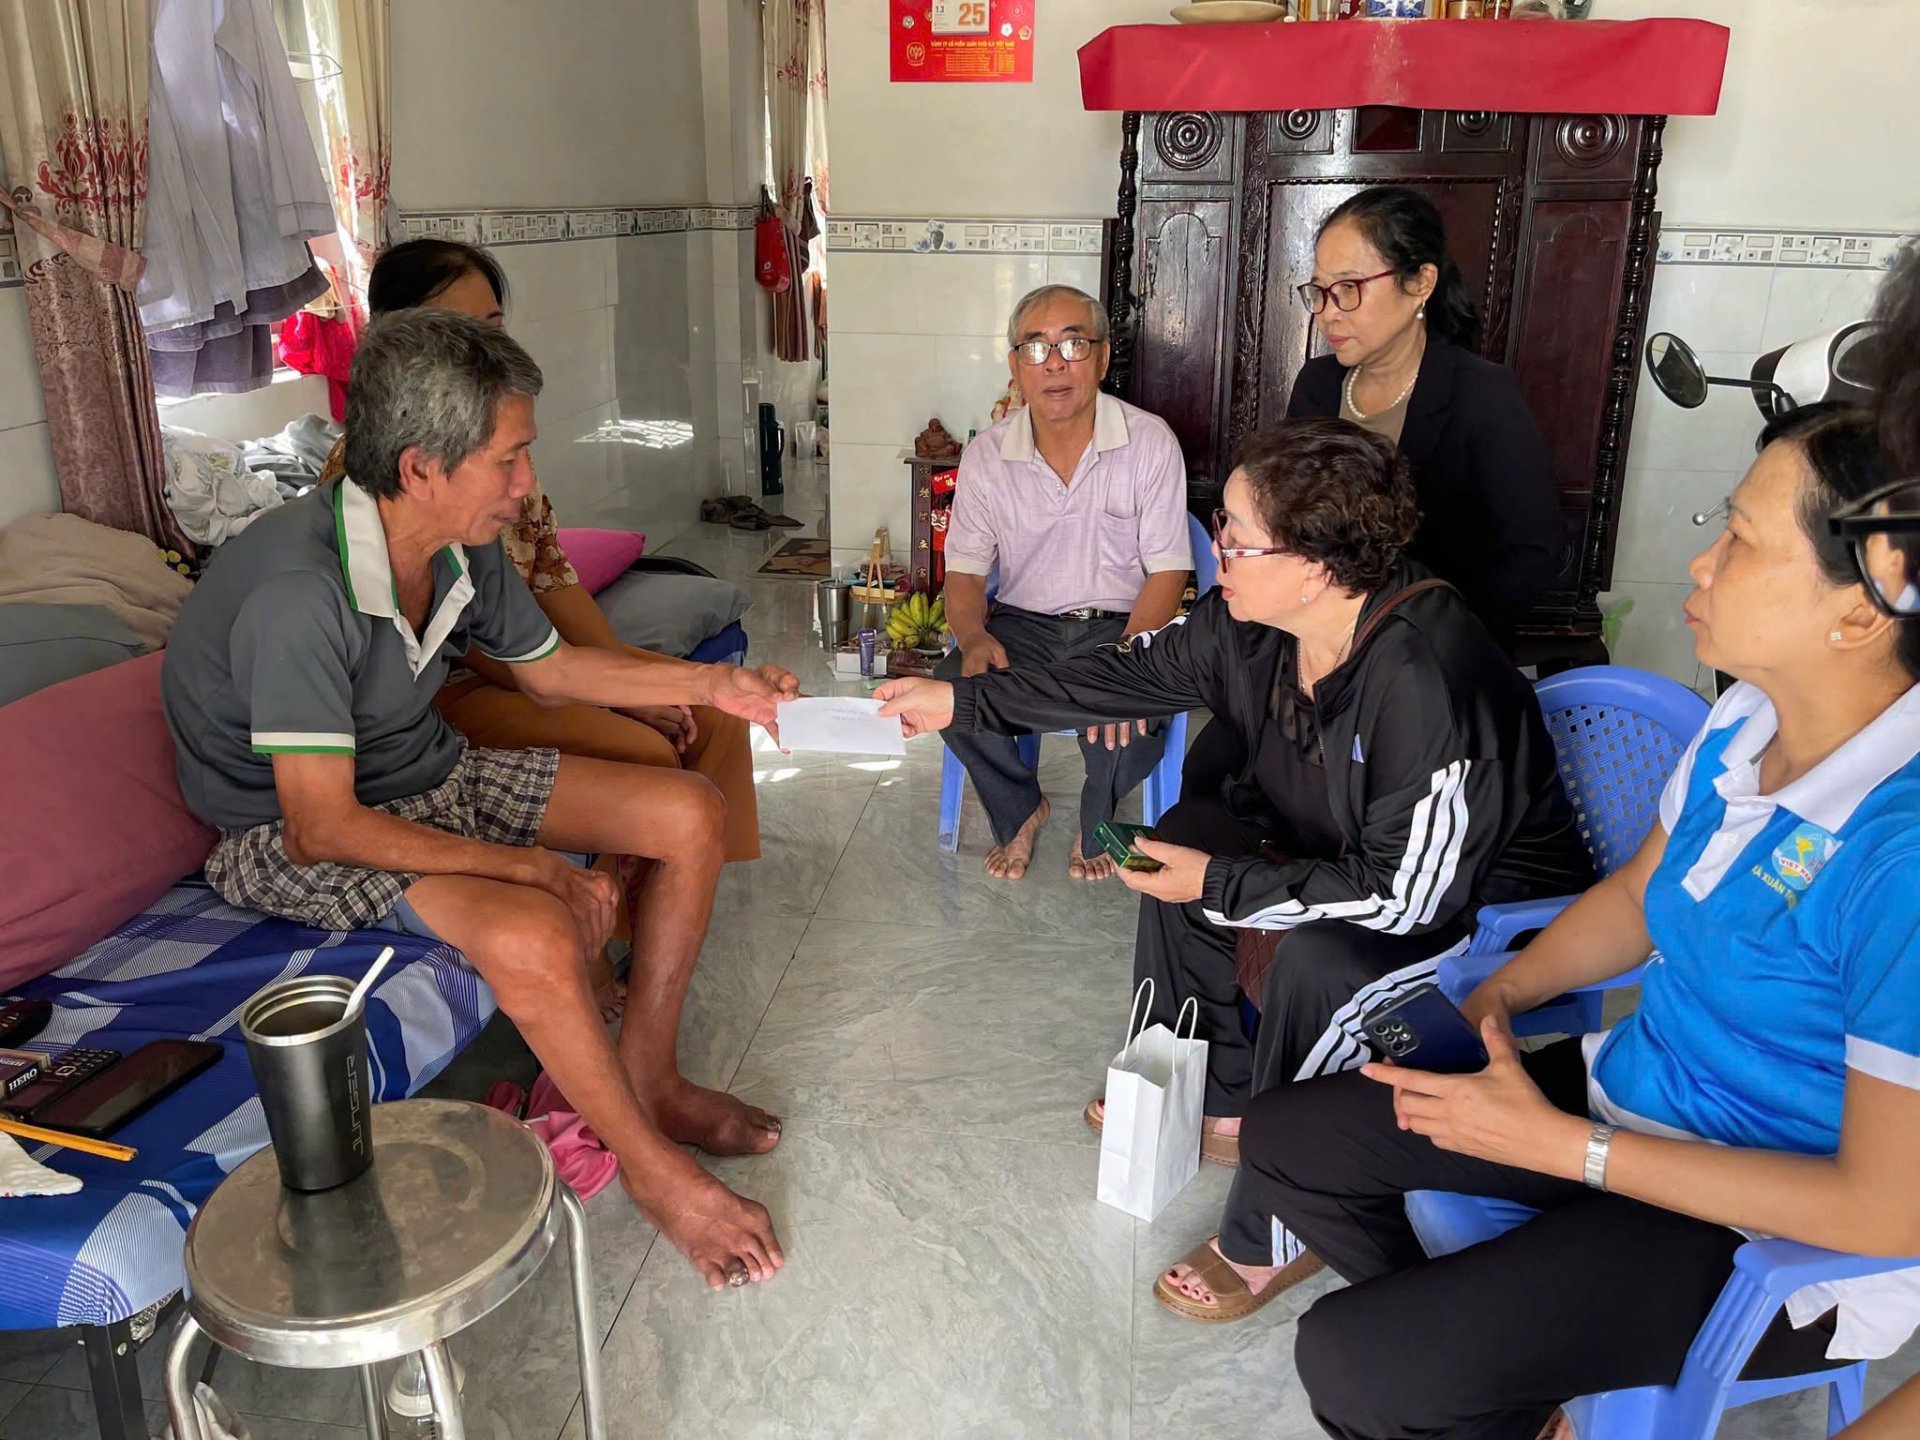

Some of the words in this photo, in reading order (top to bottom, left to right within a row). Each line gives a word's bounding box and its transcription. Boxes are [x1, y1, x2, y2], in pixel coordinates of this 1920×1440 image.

[935, 5, 945, 13] 13
[958, 3, 986, 26] 25
[8, 1068, 38, 1091] HERO
[346, 1055, 364, 1156] JUNGER
